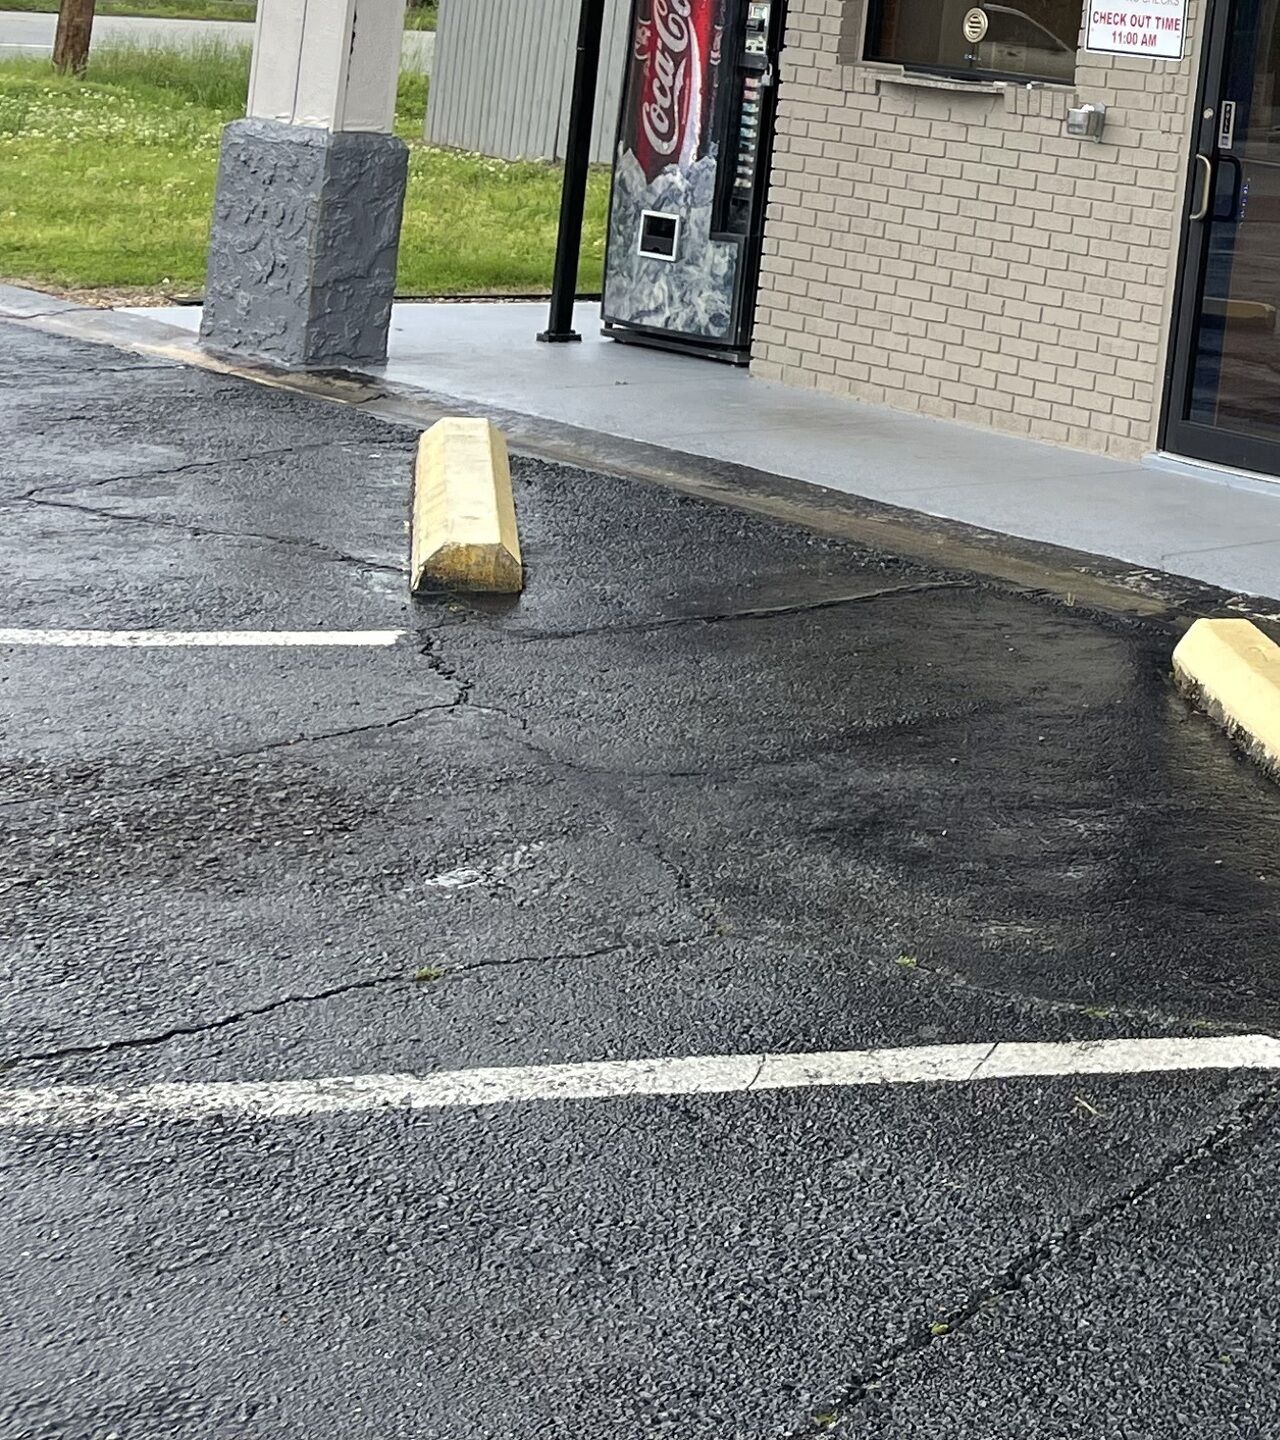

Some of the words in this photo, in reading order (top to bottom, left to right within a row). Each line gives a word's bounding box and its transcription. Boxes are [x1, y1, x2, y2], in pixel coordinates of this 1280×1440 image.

[1093, 11, 1127, 27] CHECK
[1130, 14, 1153, 28] OUT
[1155, 16, 1181, 31] TIME
[1112, 31, 1138, 46] 11:00
[1140, 33, 1157, 47] AM
[1223, 104, 1231, 133] PULL
